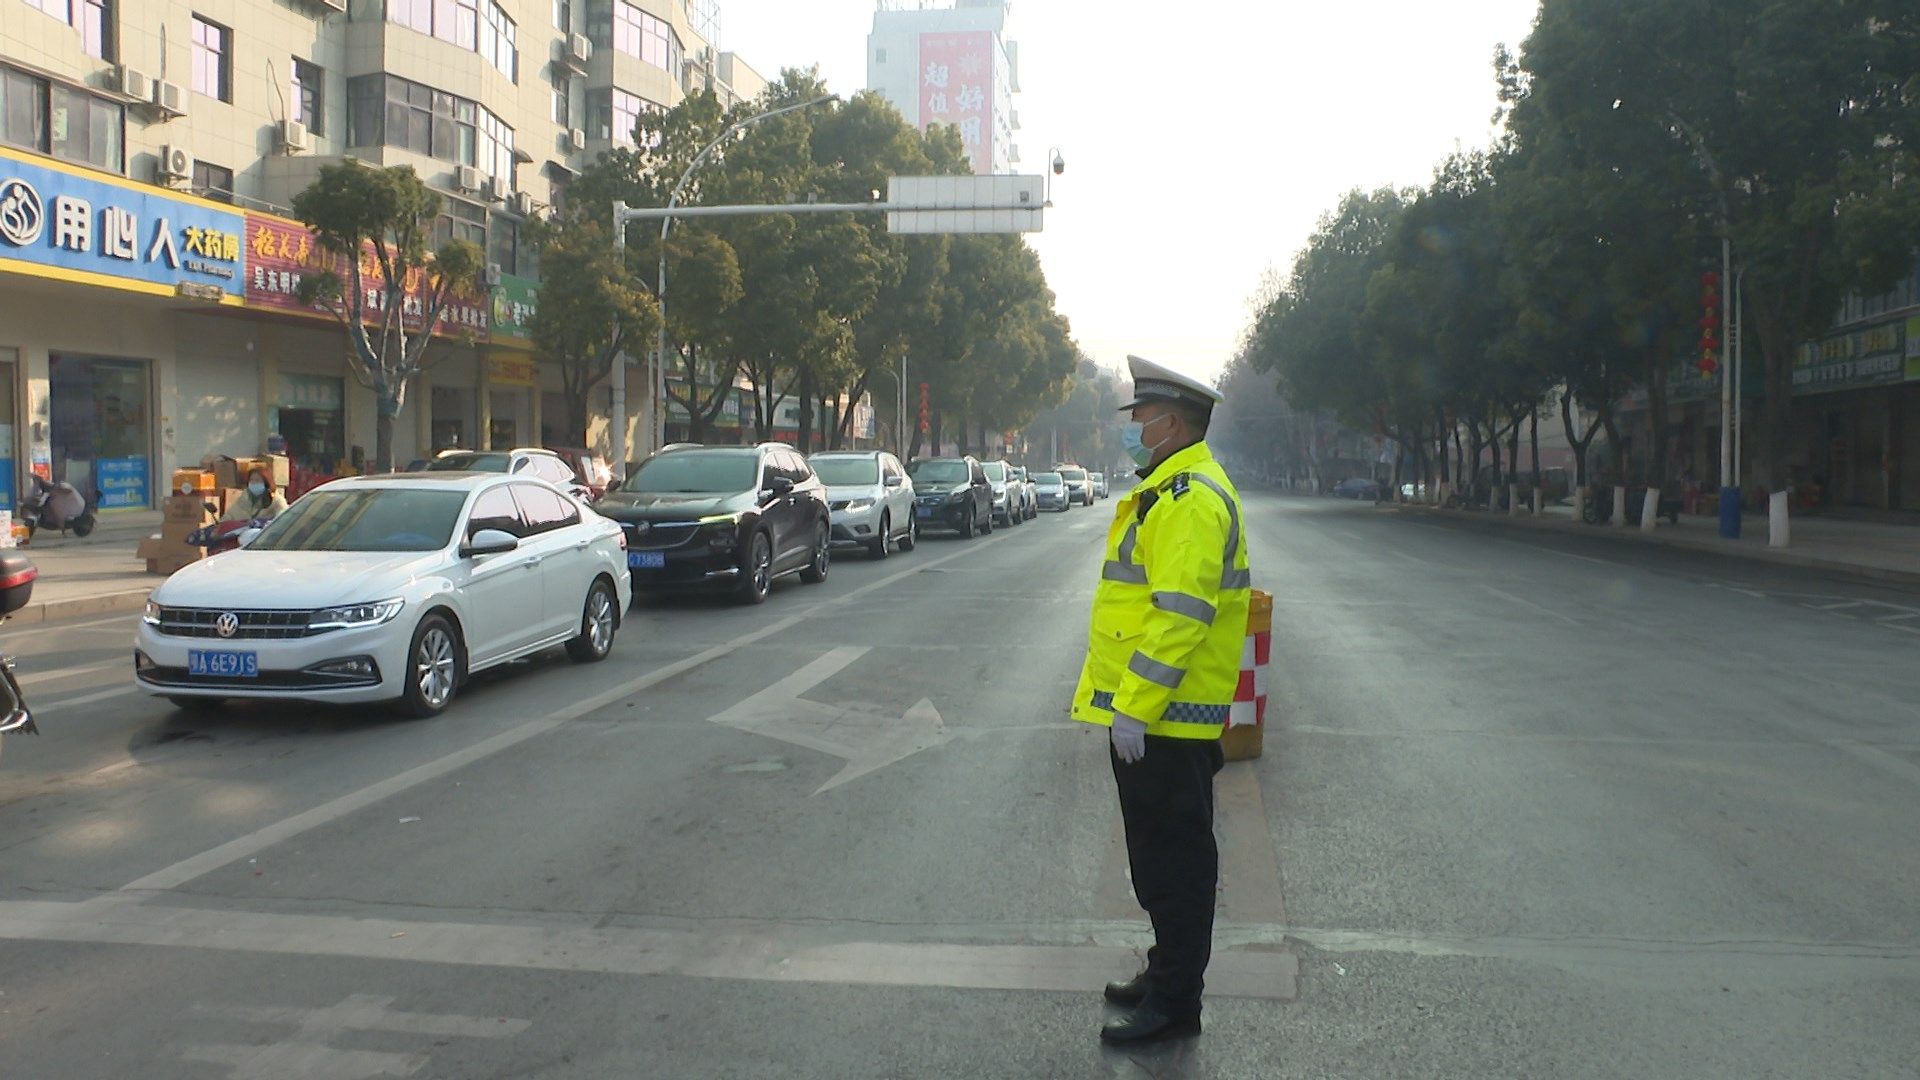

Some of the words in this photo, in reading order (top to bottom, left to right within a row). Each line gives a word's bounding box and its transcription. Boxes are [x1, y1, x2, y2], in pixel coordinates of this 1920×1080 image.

[55, 195, 180, 269] 用心人
[184, 225, 240, 262] 大药房
